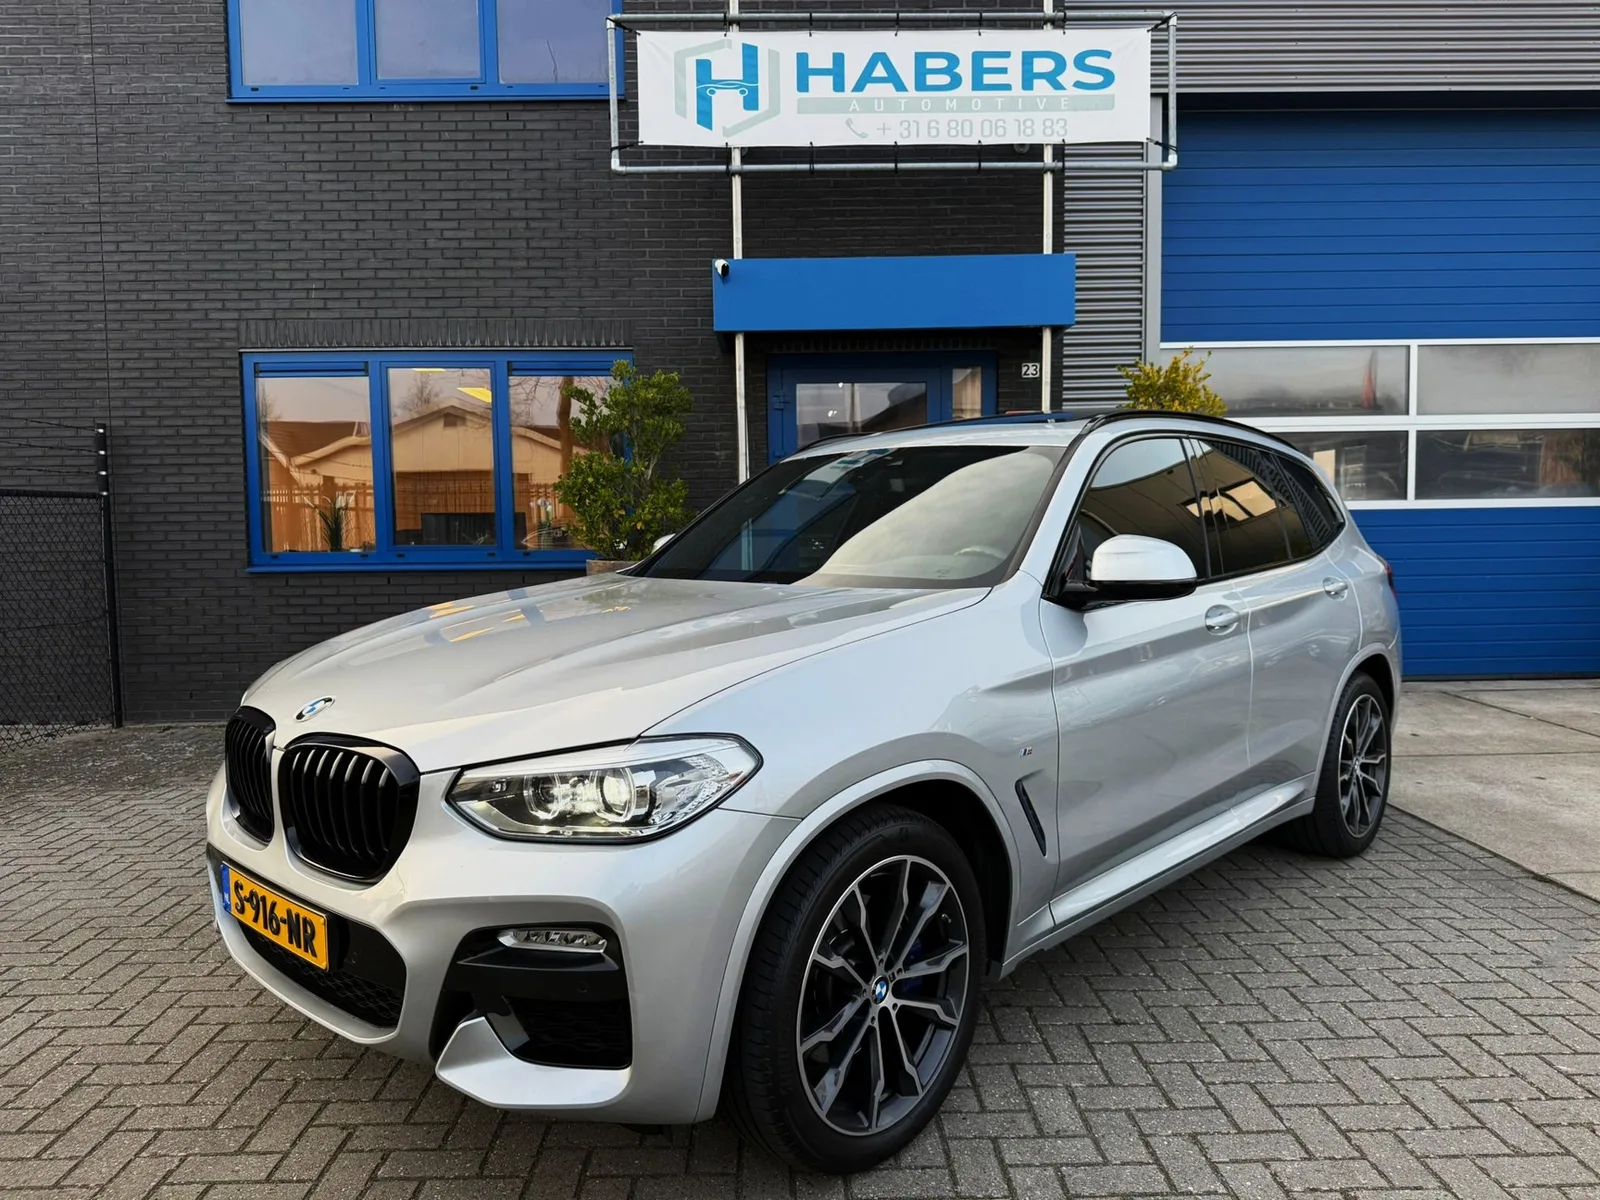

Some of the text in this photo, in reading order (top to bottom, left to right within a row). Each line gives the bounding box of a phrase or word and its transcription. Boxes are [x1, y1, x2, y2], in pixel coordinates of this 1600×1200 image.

[796, 49, 1116, 93] HABERS
[849, 97, 1069, 112] AUTOMOTIVE
[900, 121, 920, 138] 31
[927, 121, 940, 138] 6
[947, 120, 974, 138] 80
[981, 120, 1007, 137] 06
[1015, 119, 1035, 137] 18
[1042, 119, 1068, 136] 83
[1022, 364, 1038, 377] 23
[234, 879, 317, 958] S-916-NR
